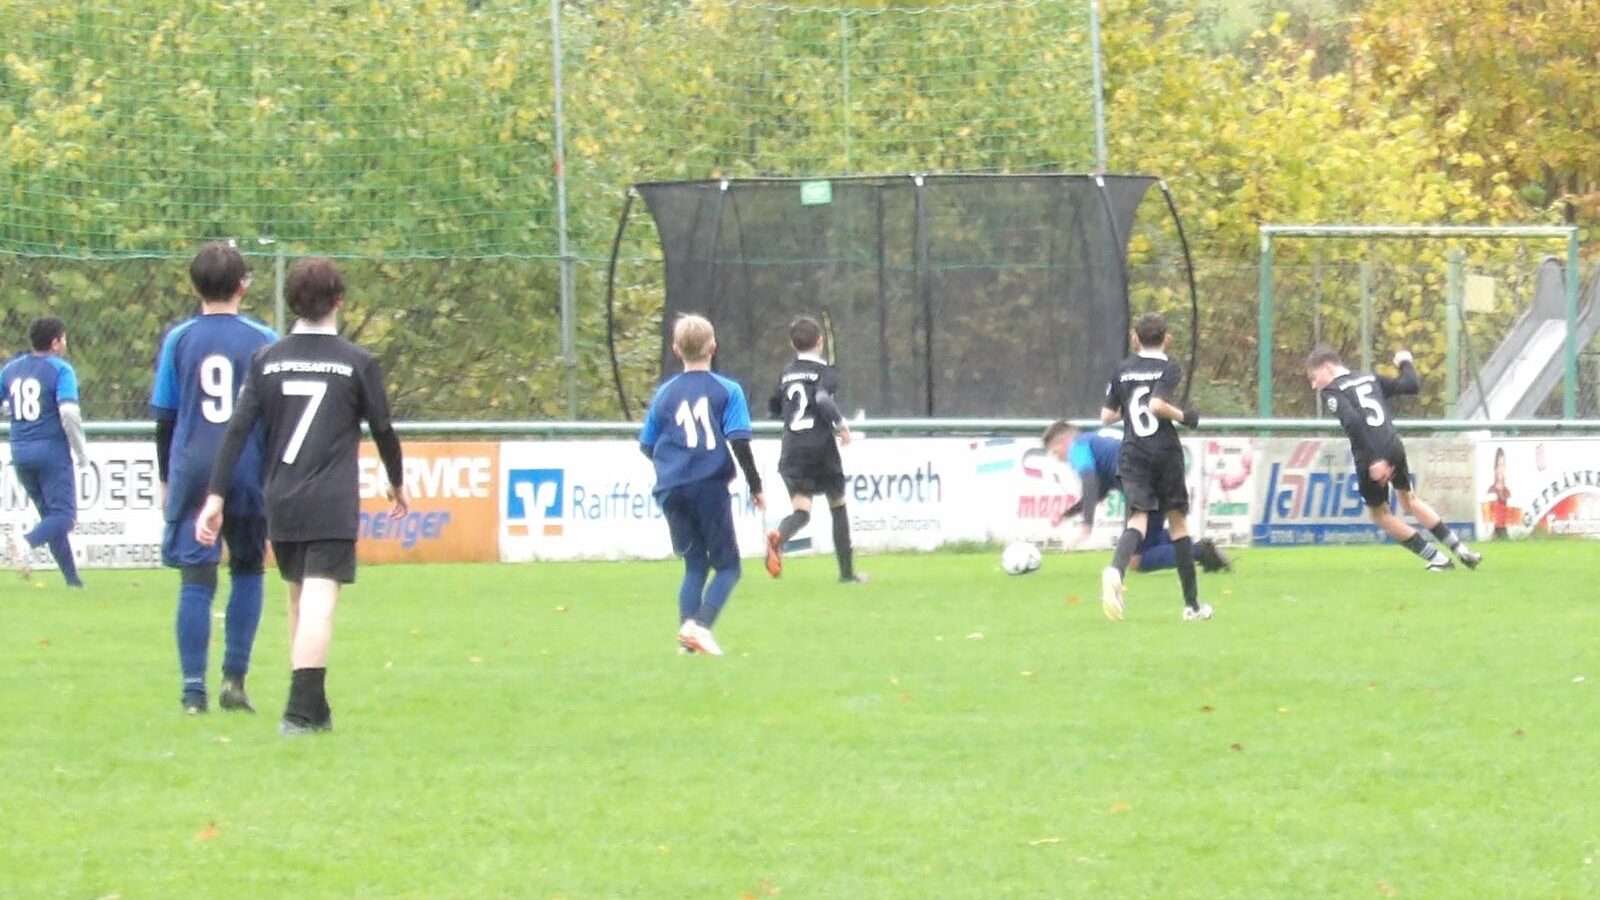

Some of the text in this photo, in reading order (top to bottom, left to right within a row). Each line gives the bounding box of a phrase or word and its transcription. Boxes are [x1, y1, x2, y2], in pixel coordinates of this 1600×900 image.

[9, 378, 41, 421] 18
[201, 355, 233, 423] 9
[788, 383, 815, 431] 2
[1129, 386, 1159, 437] 6
[1356, 383, 1385, 427] 5
[282, 381, 327, 464] 7
[675, 397, 716, 450] 11
